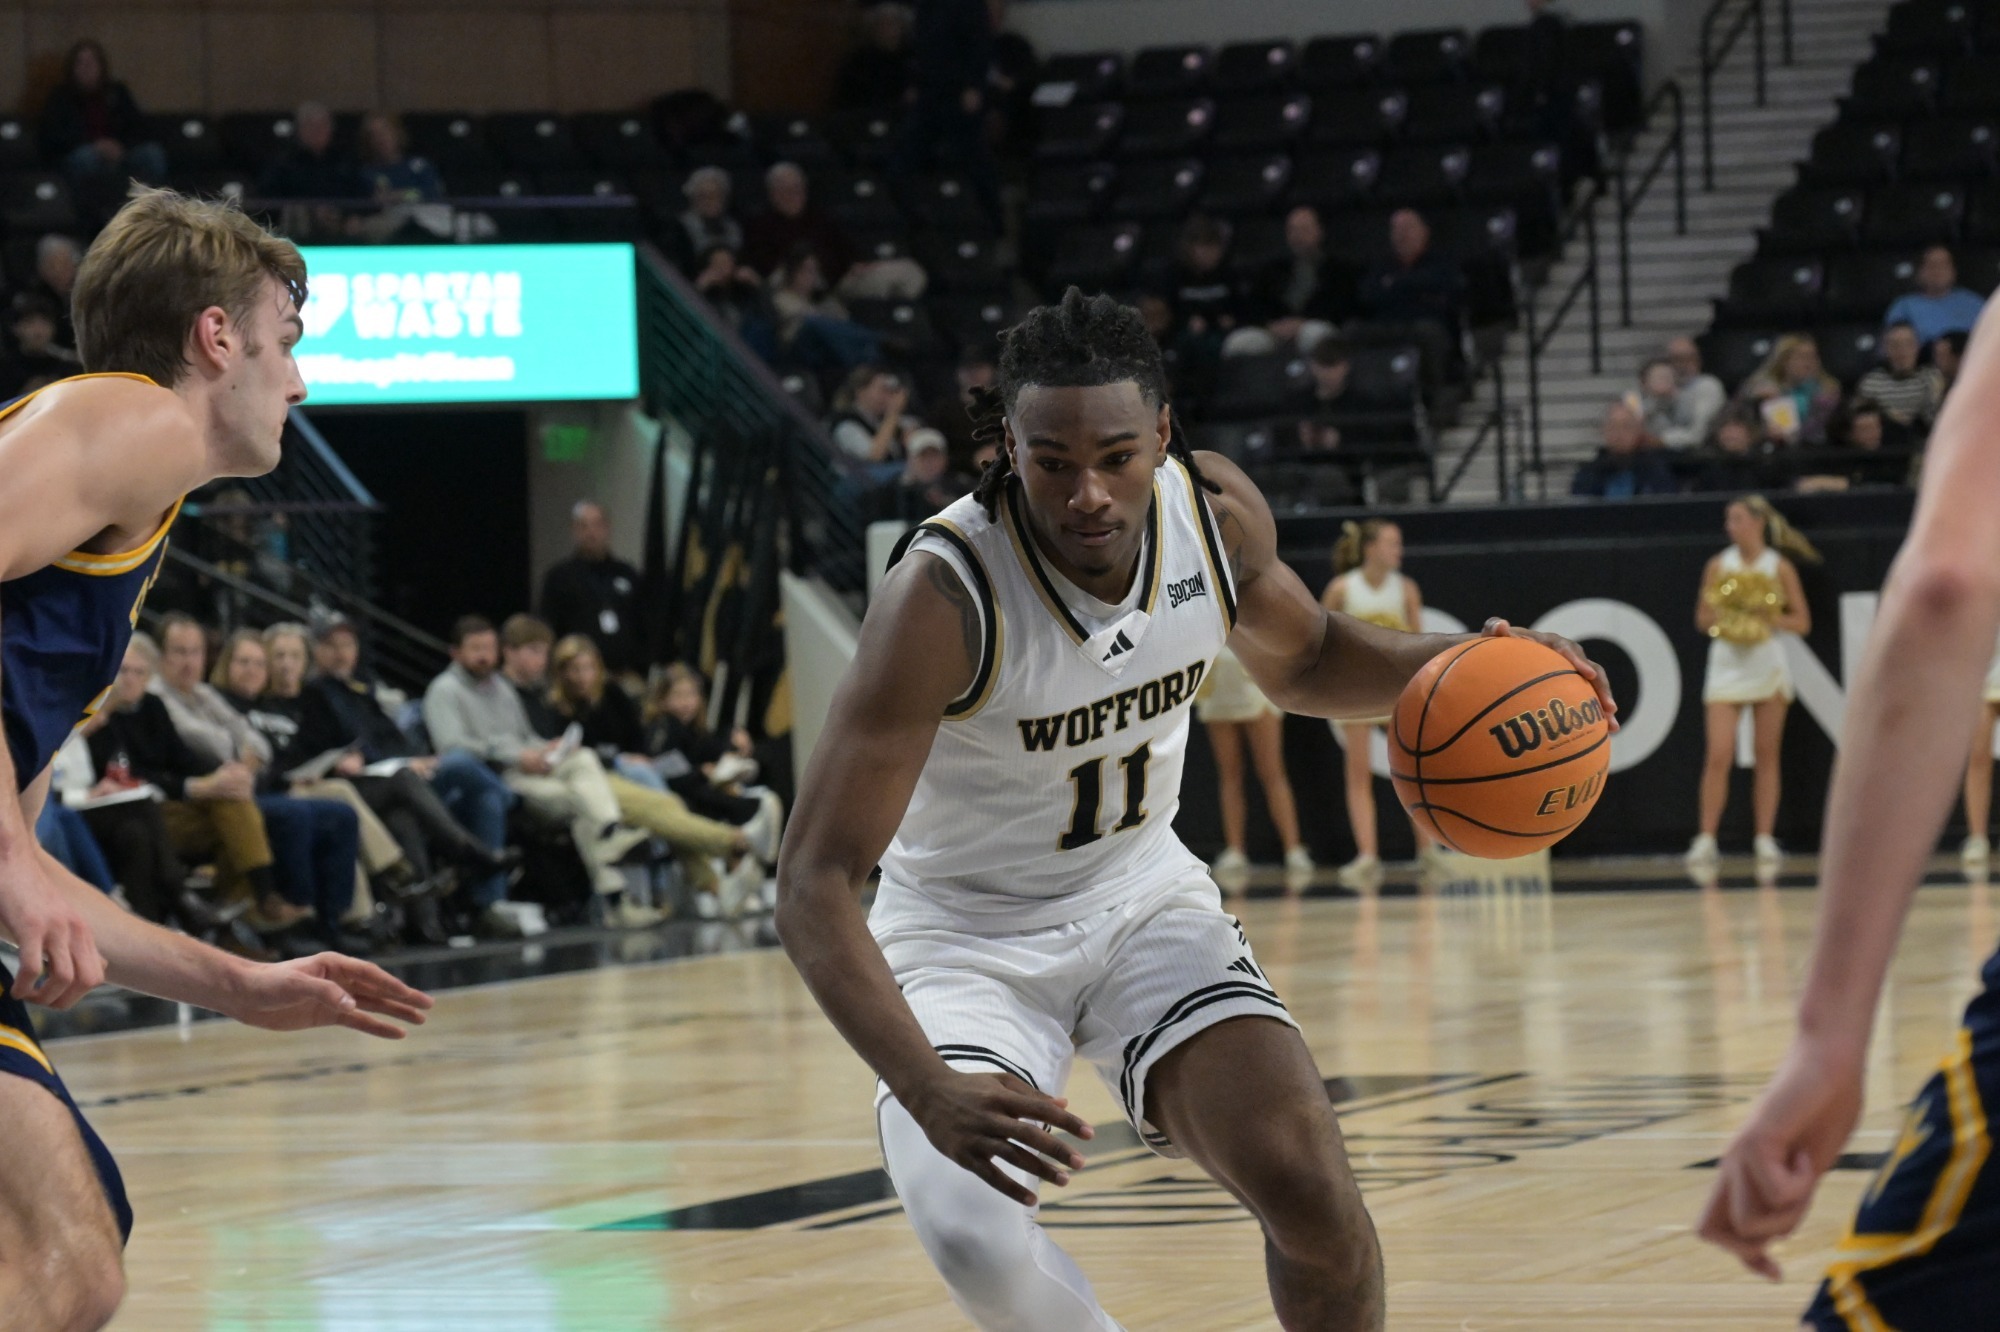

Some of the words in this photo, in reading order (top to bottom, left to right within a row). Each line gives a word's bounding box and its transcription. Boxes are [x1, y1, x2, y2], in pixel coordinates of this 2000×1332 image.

[351, 299, 522, 338] WASTE
[1016, 659, 1206, 752] WOFFORD
[1489, 697, 1605, 758] Wilson
[1056, 737, 1154, 852] 11
